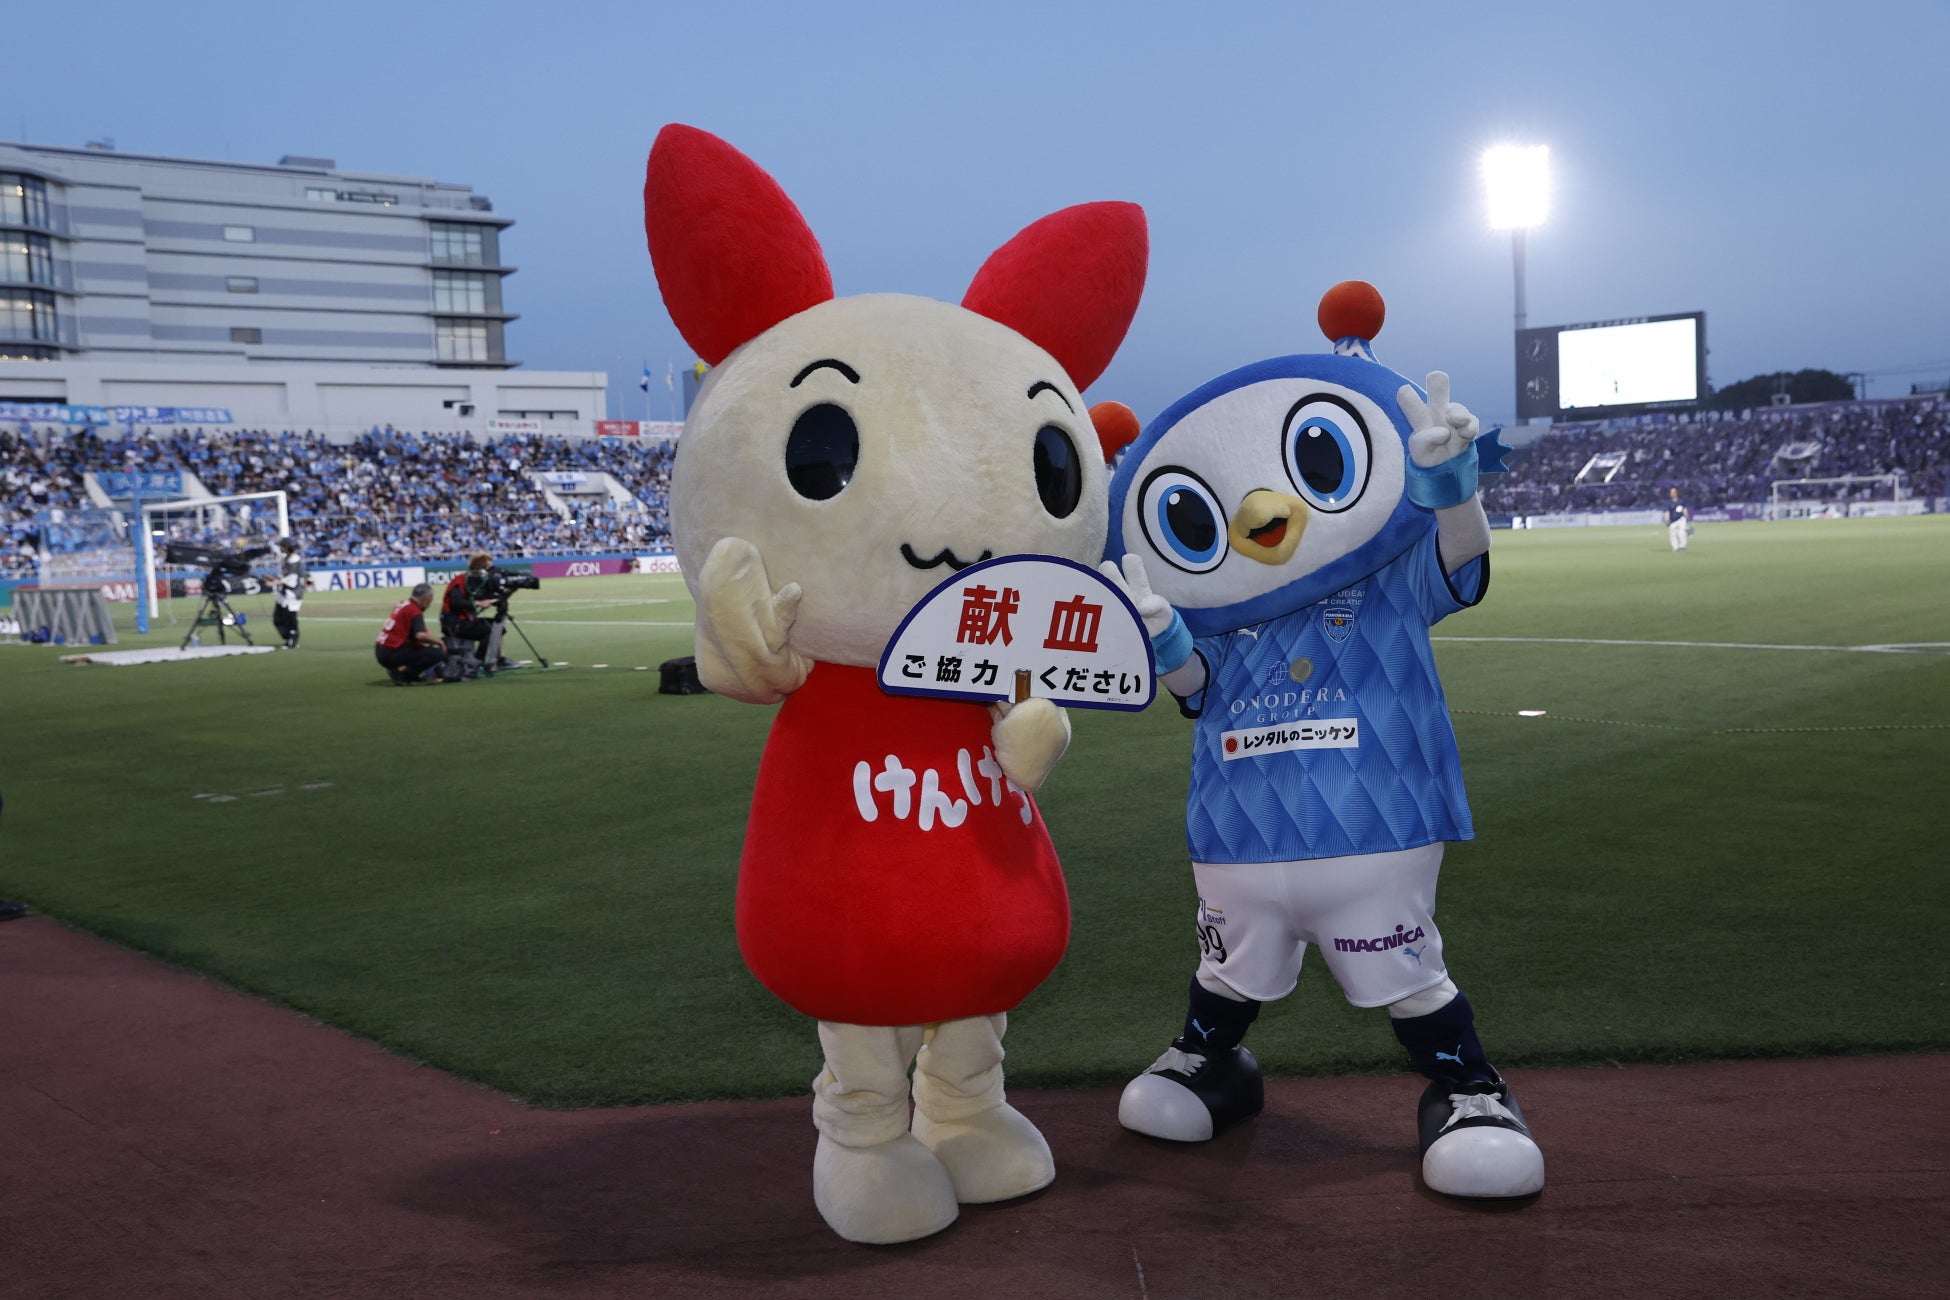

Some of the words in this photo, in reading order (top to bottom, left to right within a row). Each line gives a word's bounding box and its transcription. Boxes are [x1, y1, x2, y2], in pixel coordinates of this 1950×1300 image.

[1230, 687, 1347, 714] ONODERA
[1257, 706, 1315, 722] GROUP
[1243, 726, 1356, 749] レンタルのニッケン
